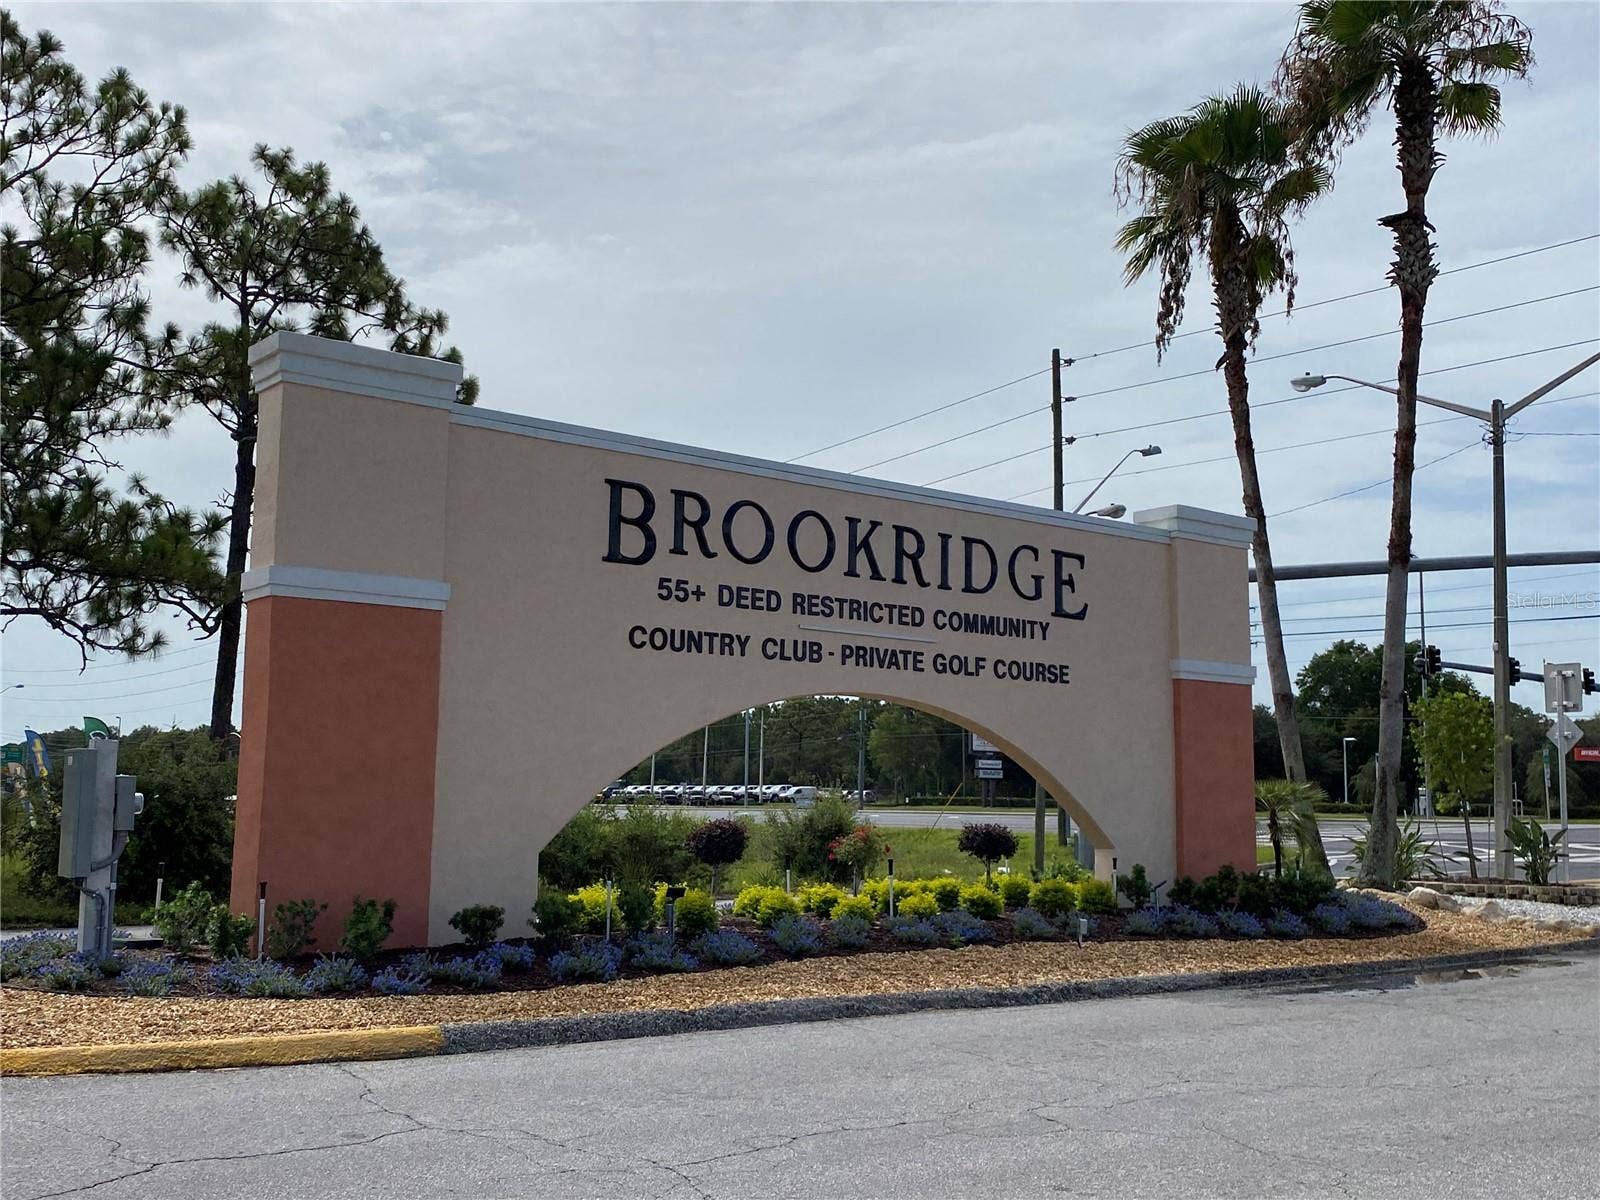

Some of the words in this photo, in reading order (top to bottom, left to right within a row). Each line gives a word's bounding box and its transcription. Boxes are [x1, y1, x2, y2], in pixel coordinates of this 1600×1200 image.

[601, 478, 1089, 621] BROOKRIDGE
[657, 577, 706, 602] 55+
[718, 584, 782, 613] DEED
[792, 592, 925, 629] RESTRICTED
[933, 609, 1051, 641] COMMUNITY
[628, 625, 751, 658] COUNTRY
[762, 637, 823, 664] CLUB
[841, 644, 925, 674] PRIVATE
[933, 654, 986, 678] GOLF
[994, 658, 1070, 685] COURSE
